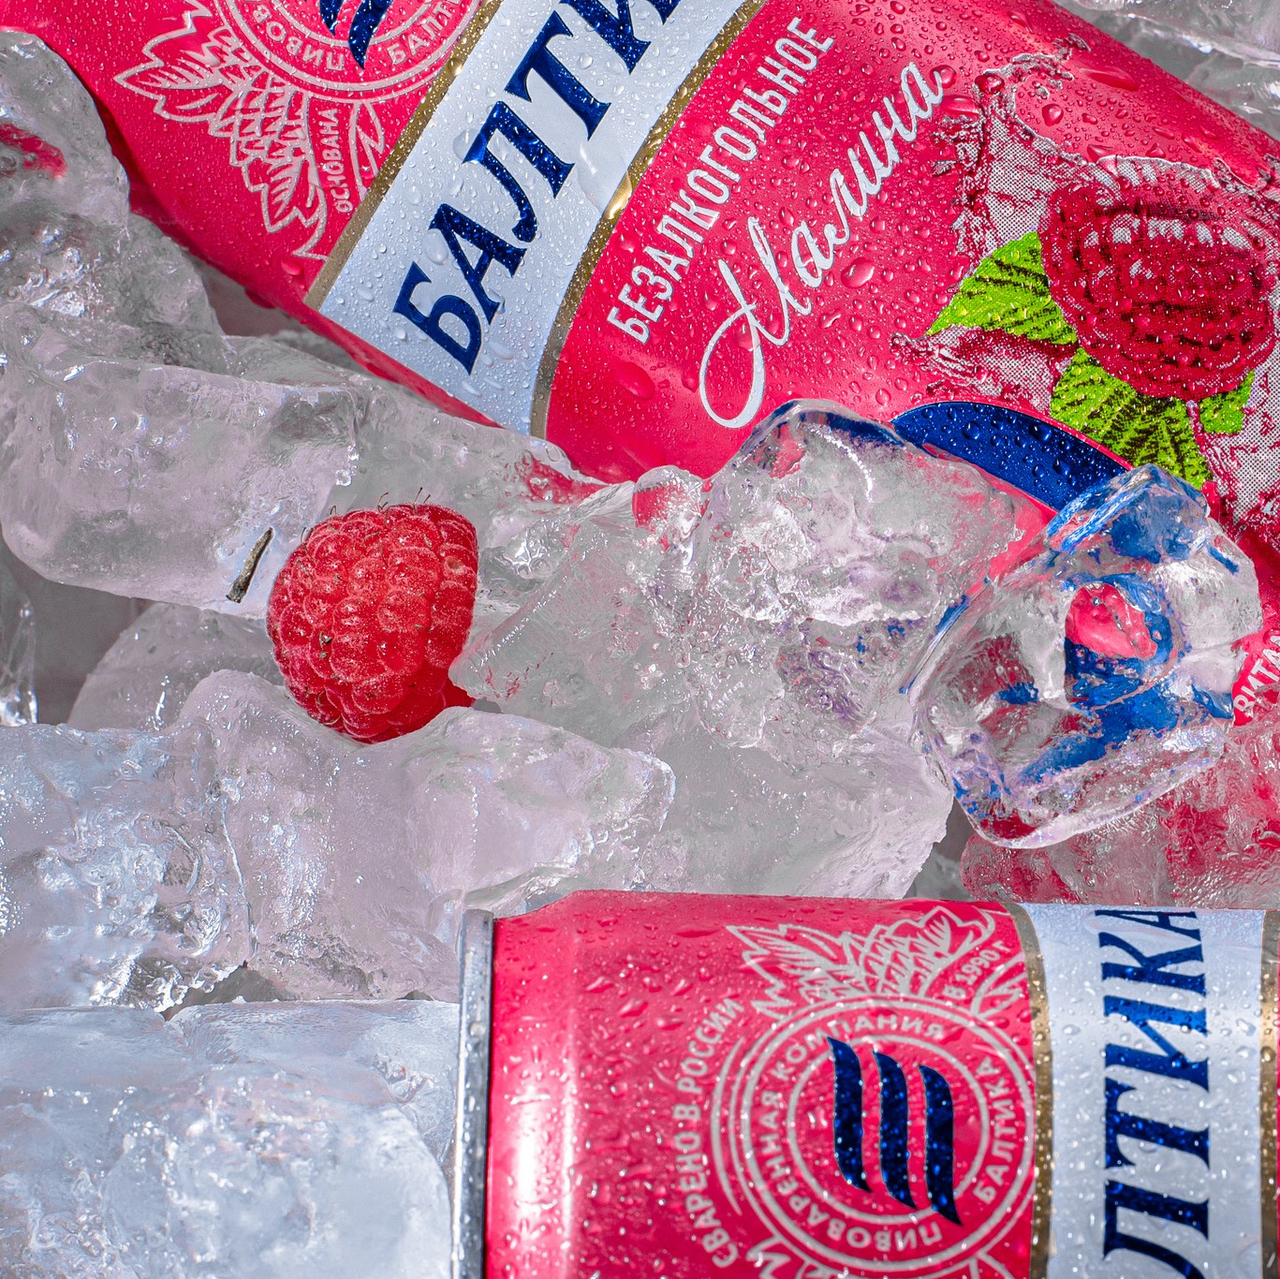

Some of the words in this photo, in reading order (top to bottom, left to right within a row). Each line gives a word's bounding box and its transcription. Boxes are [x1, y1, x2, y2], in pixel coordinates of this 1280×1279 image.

[318, 107, 354, 214] ОСНОВАНА
[607, 17, 835, 345] БЕЗАЛКОГОЛЬНОЕ
[942, 984, 967, 1000] В
[955, 948, 1000, 986] 1990
[676, 997, 745, 1095] РОССИИ
[772, 1014, 945, 1081] КОМПАНИЯ
[673, 1103, 702, 1123] В
[972, 1057, 1017, 1205] БАЛТИКА
[673, 1126, 739, 1268] СВАРЕНО
[758, 1090, 944, 1253] ПИВОВАРЕННАЯ
